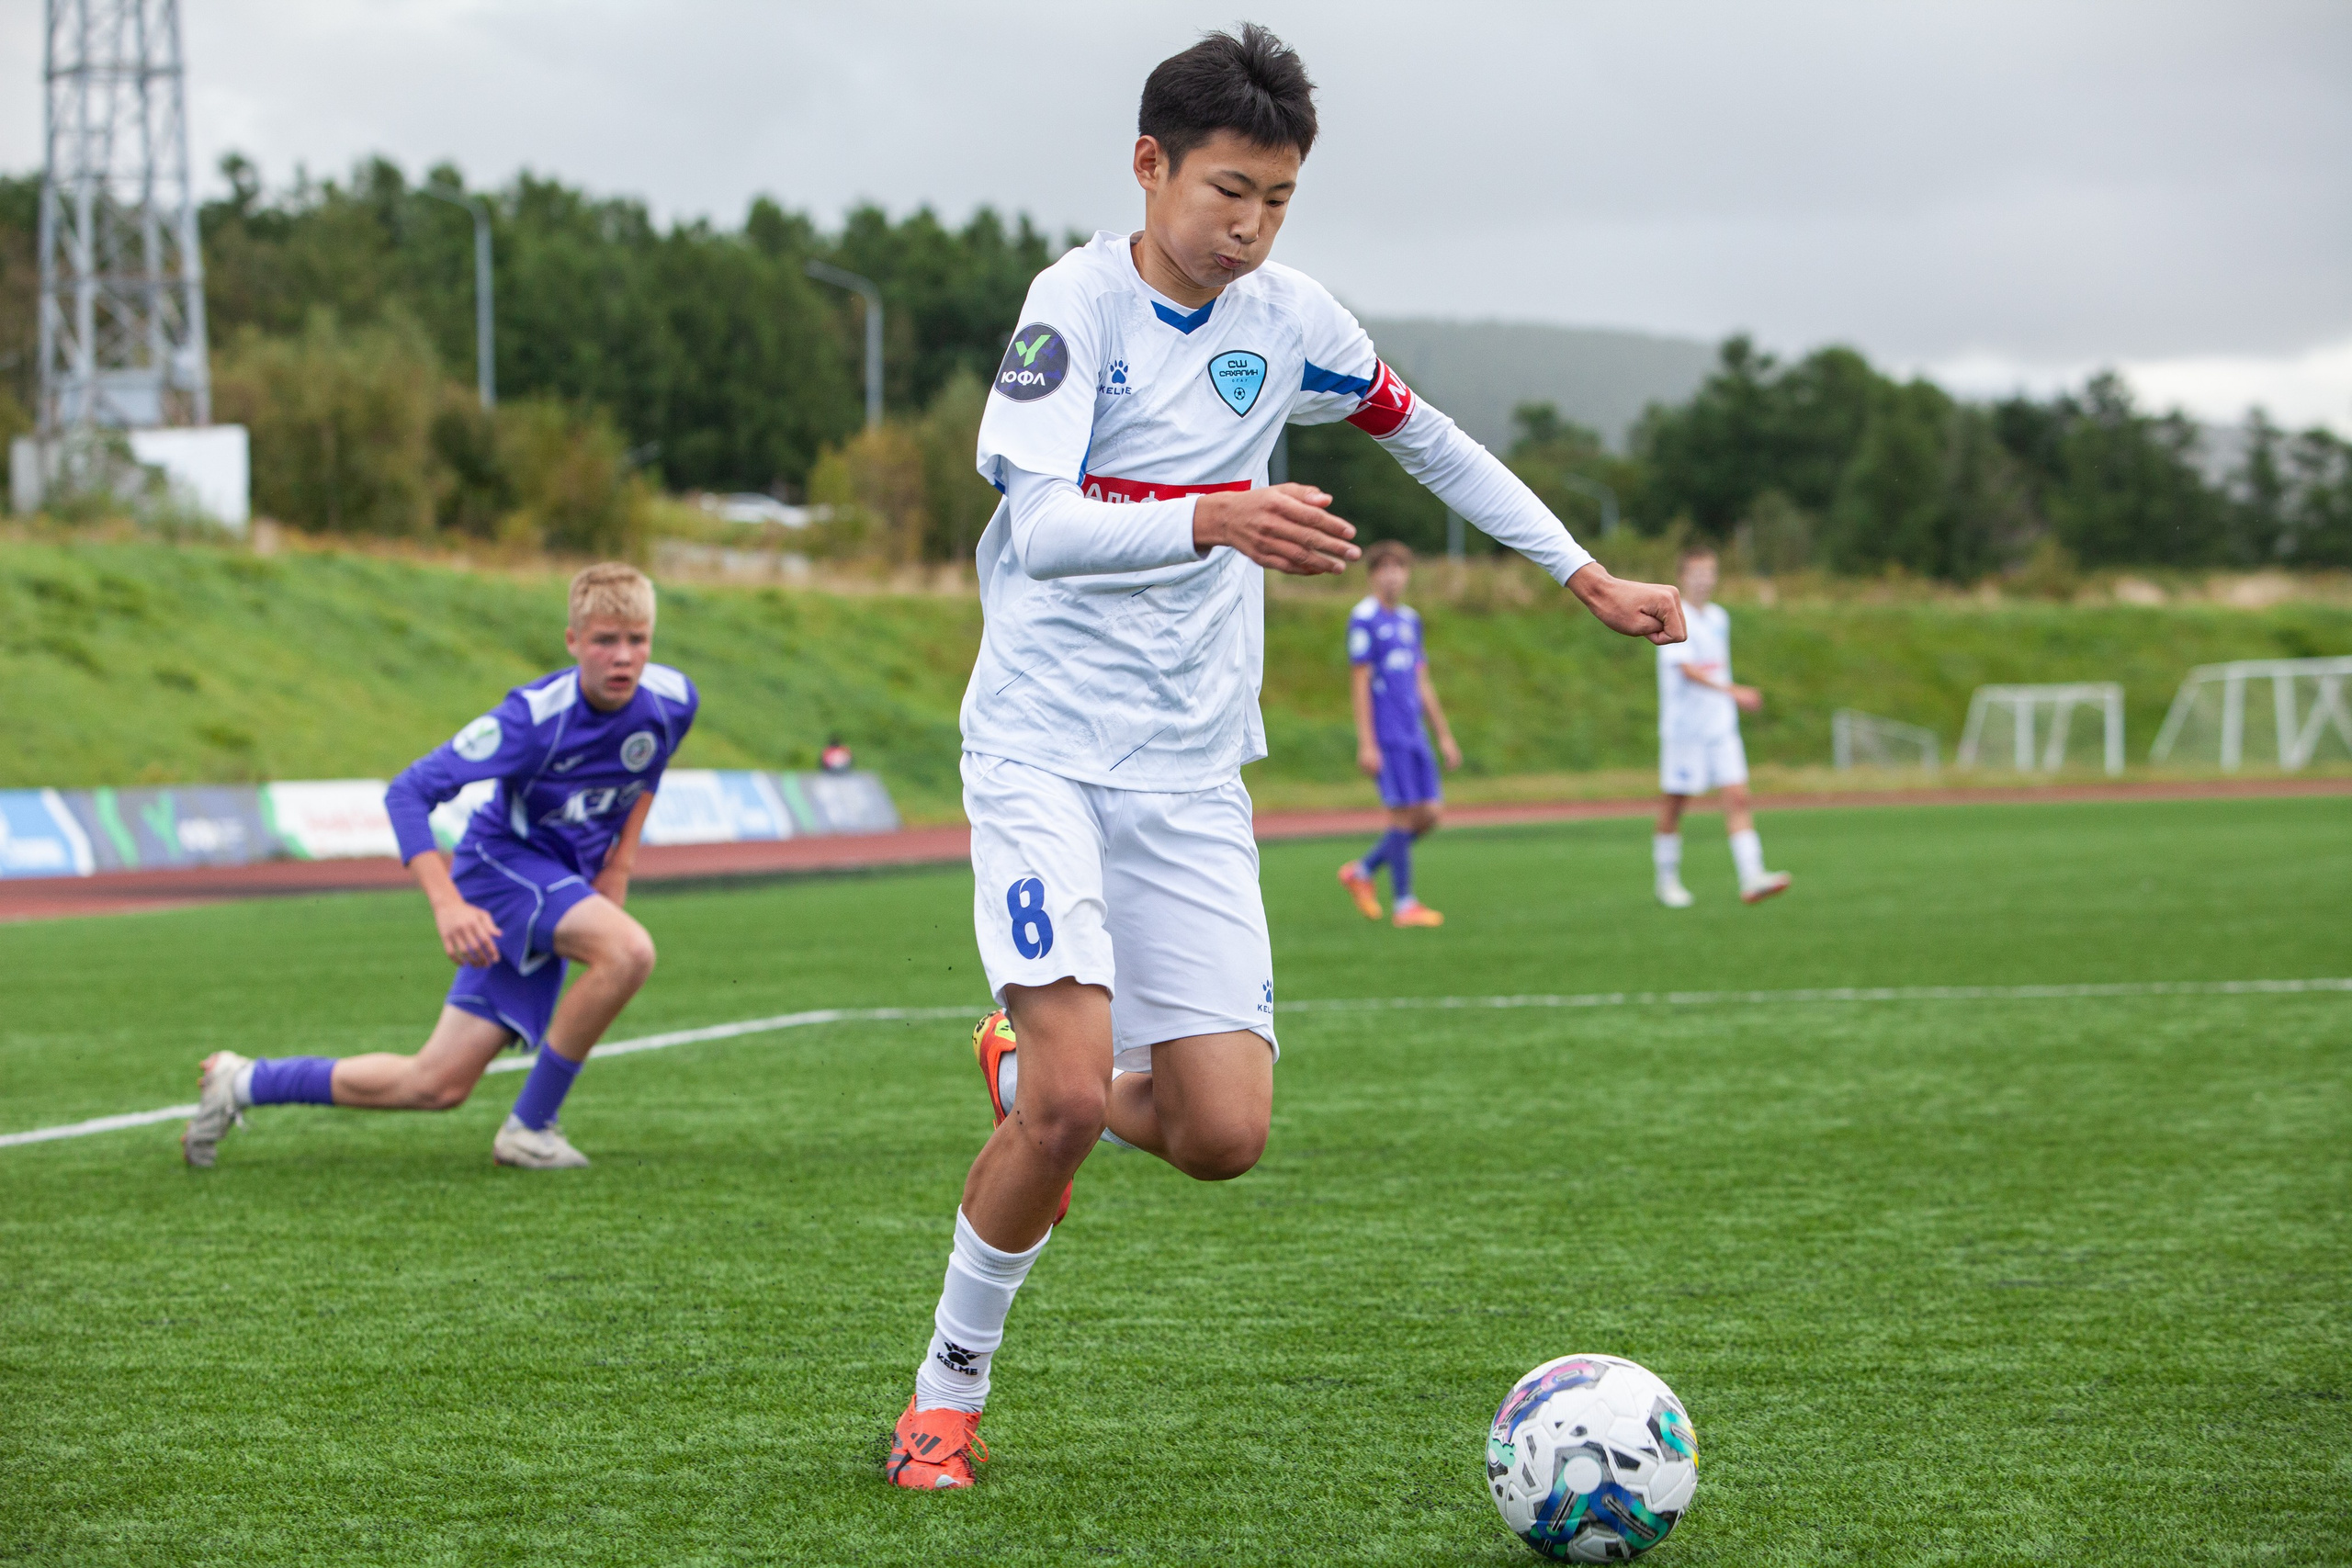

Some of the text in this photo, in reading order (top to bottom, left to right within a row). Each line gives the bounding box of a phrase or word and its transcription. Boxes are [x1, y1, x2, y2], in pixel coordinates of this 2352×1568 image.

[1227, 359, 1248, 368] СШ
[1001, 370, 1046, 387] ЮФЛ
[1006, 877, 1054, 960] 8
[936, 1352, 978, 1376] KELME
